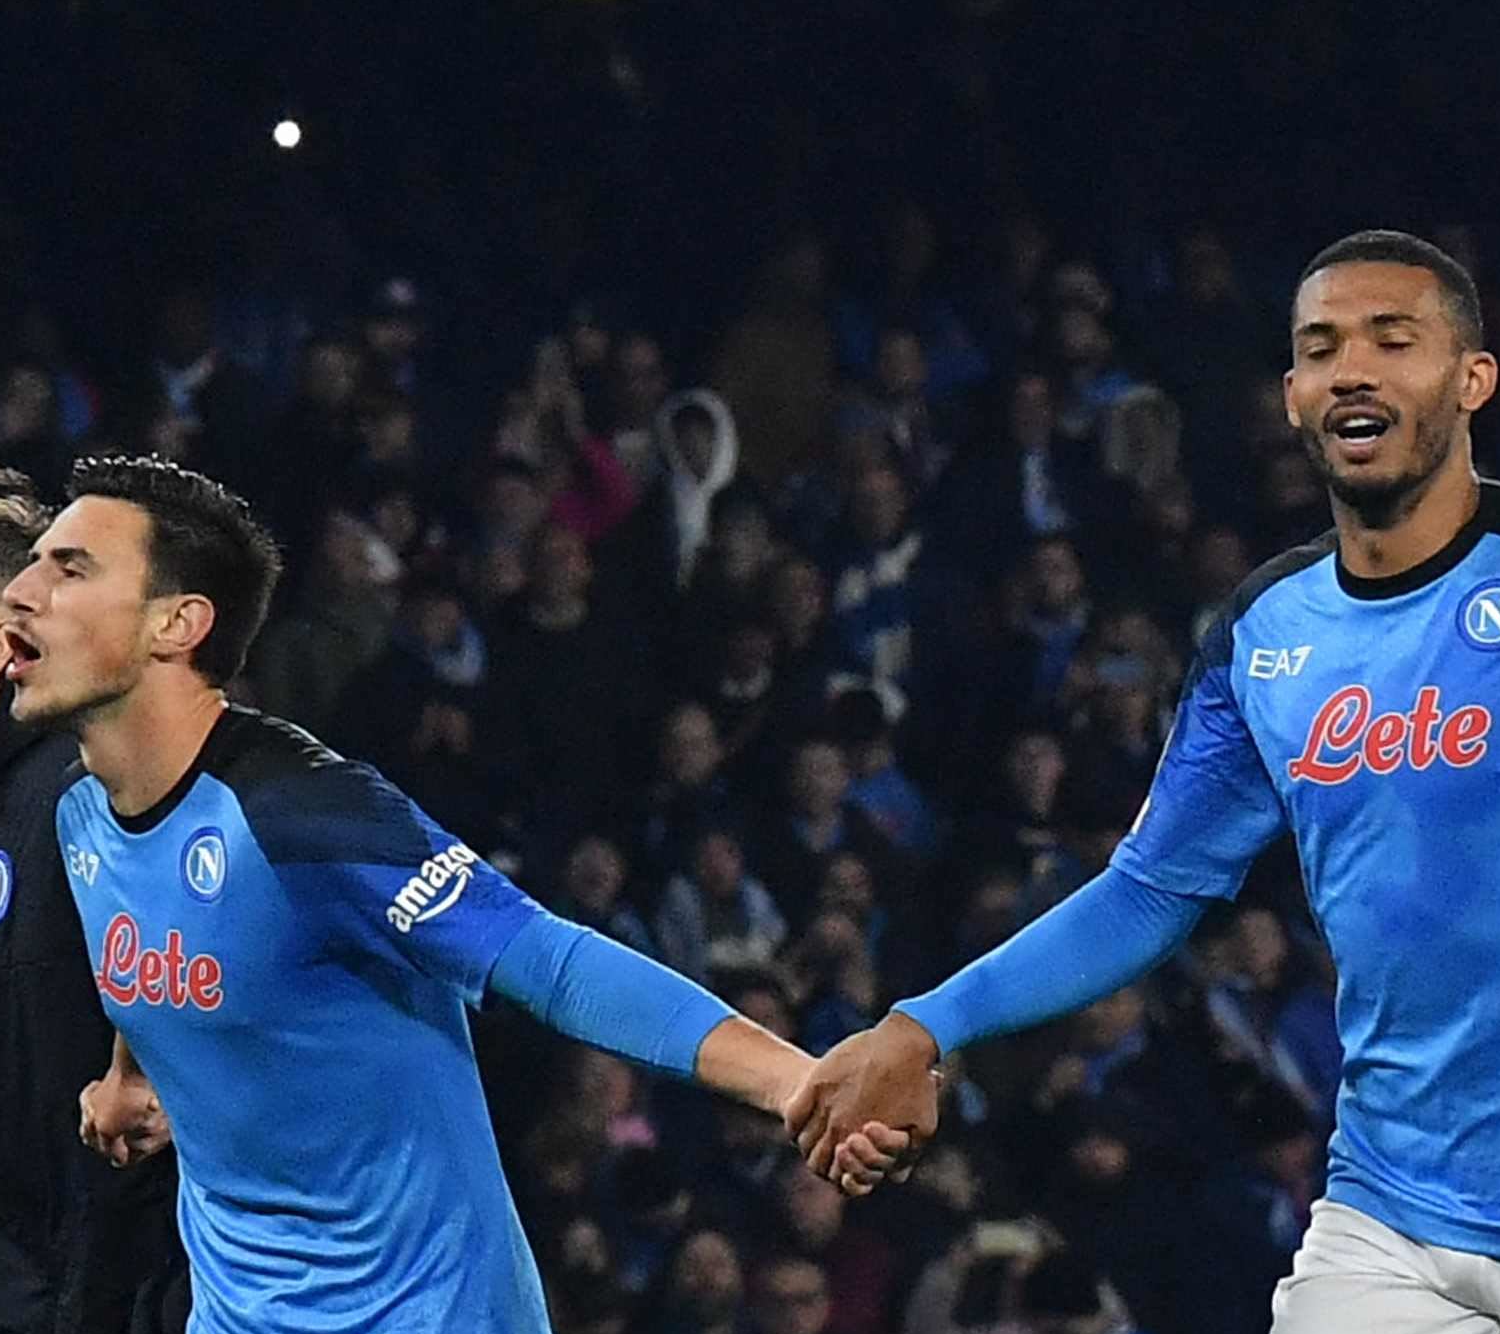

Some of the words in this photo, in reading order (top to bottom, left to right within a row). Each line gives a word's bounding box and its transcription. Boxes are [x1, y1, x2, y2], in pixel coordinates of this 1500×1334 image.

[1247, 644, 1314, 680] EA7
[1287, 683, 1493, 786] Lete
[196, 846, 222, 883] N
[386, 842, 478, 933] amazo
[95, 911, 223, 1011] Lete
